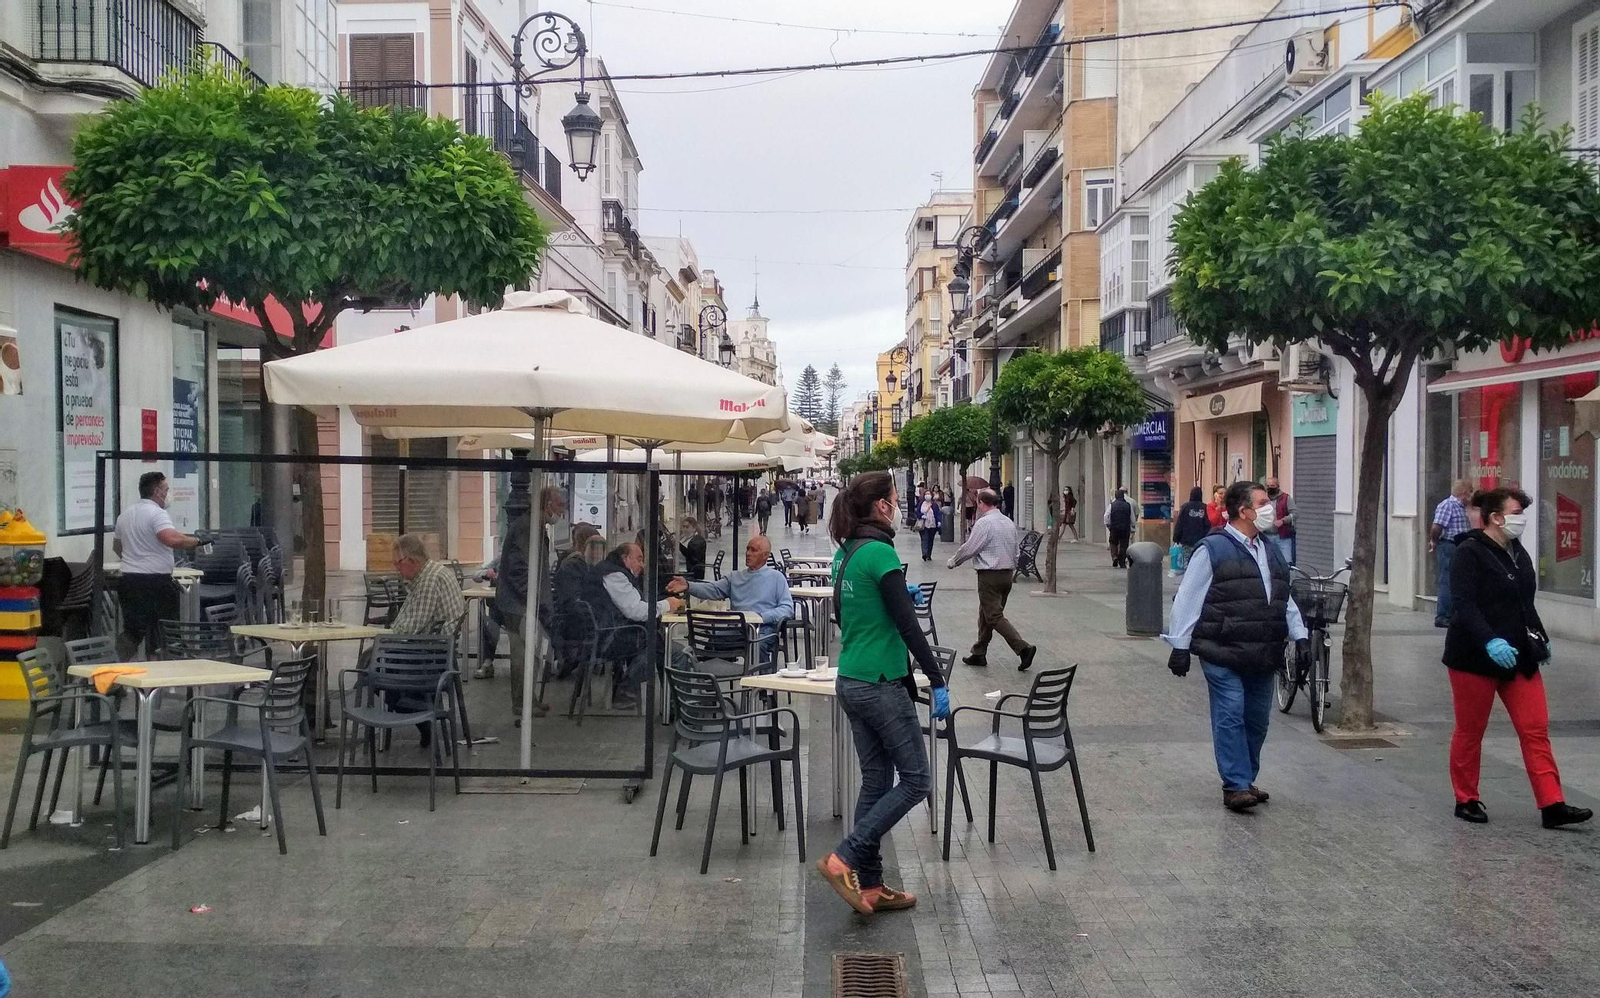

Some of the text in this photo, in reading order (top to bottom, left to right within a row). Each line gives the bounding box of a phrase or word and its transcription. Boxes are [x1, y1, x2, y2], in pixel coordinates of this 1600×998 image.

[64, 354, 89, 371] negocio
[65, 372, 79, 387] está
[65, 393, 93, 409] a prueba
[65, 411, 105, 430] de percances
[66, 430, 105, 449] imprevistos?
[1548, 461, 1589, 479] vodafone
